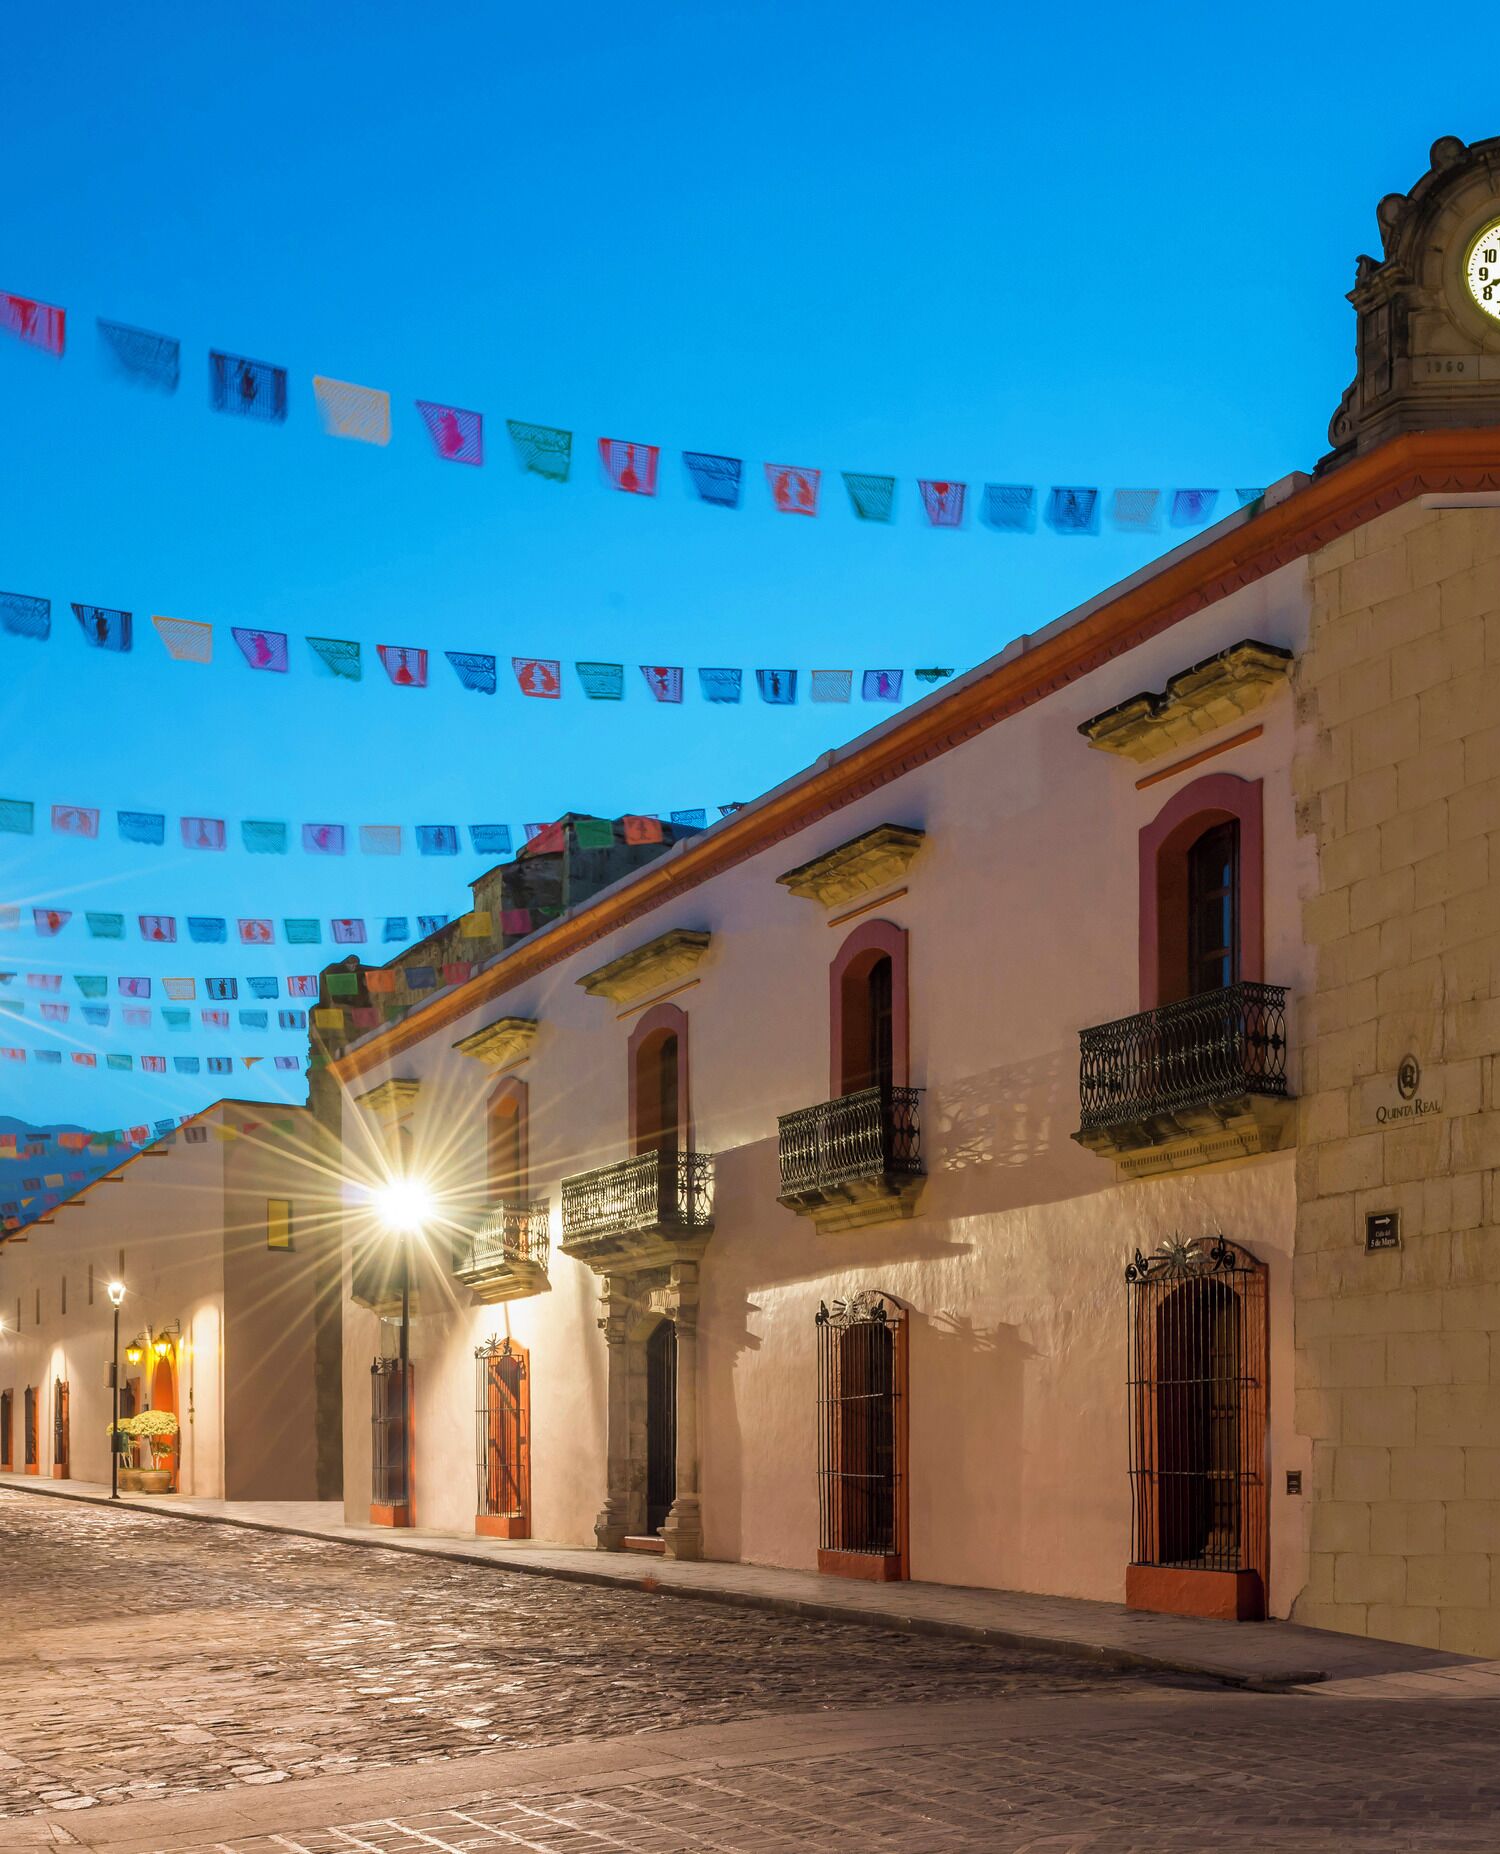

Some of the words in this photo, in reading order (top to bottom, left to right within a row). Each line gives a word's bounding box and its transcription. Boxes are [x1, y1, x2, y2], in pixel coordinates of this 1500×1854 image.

[1483, 249, 1497, 263] 10
[1479, 267, 1489, 281] 9
[1483, 286, 1492, 300] 8
